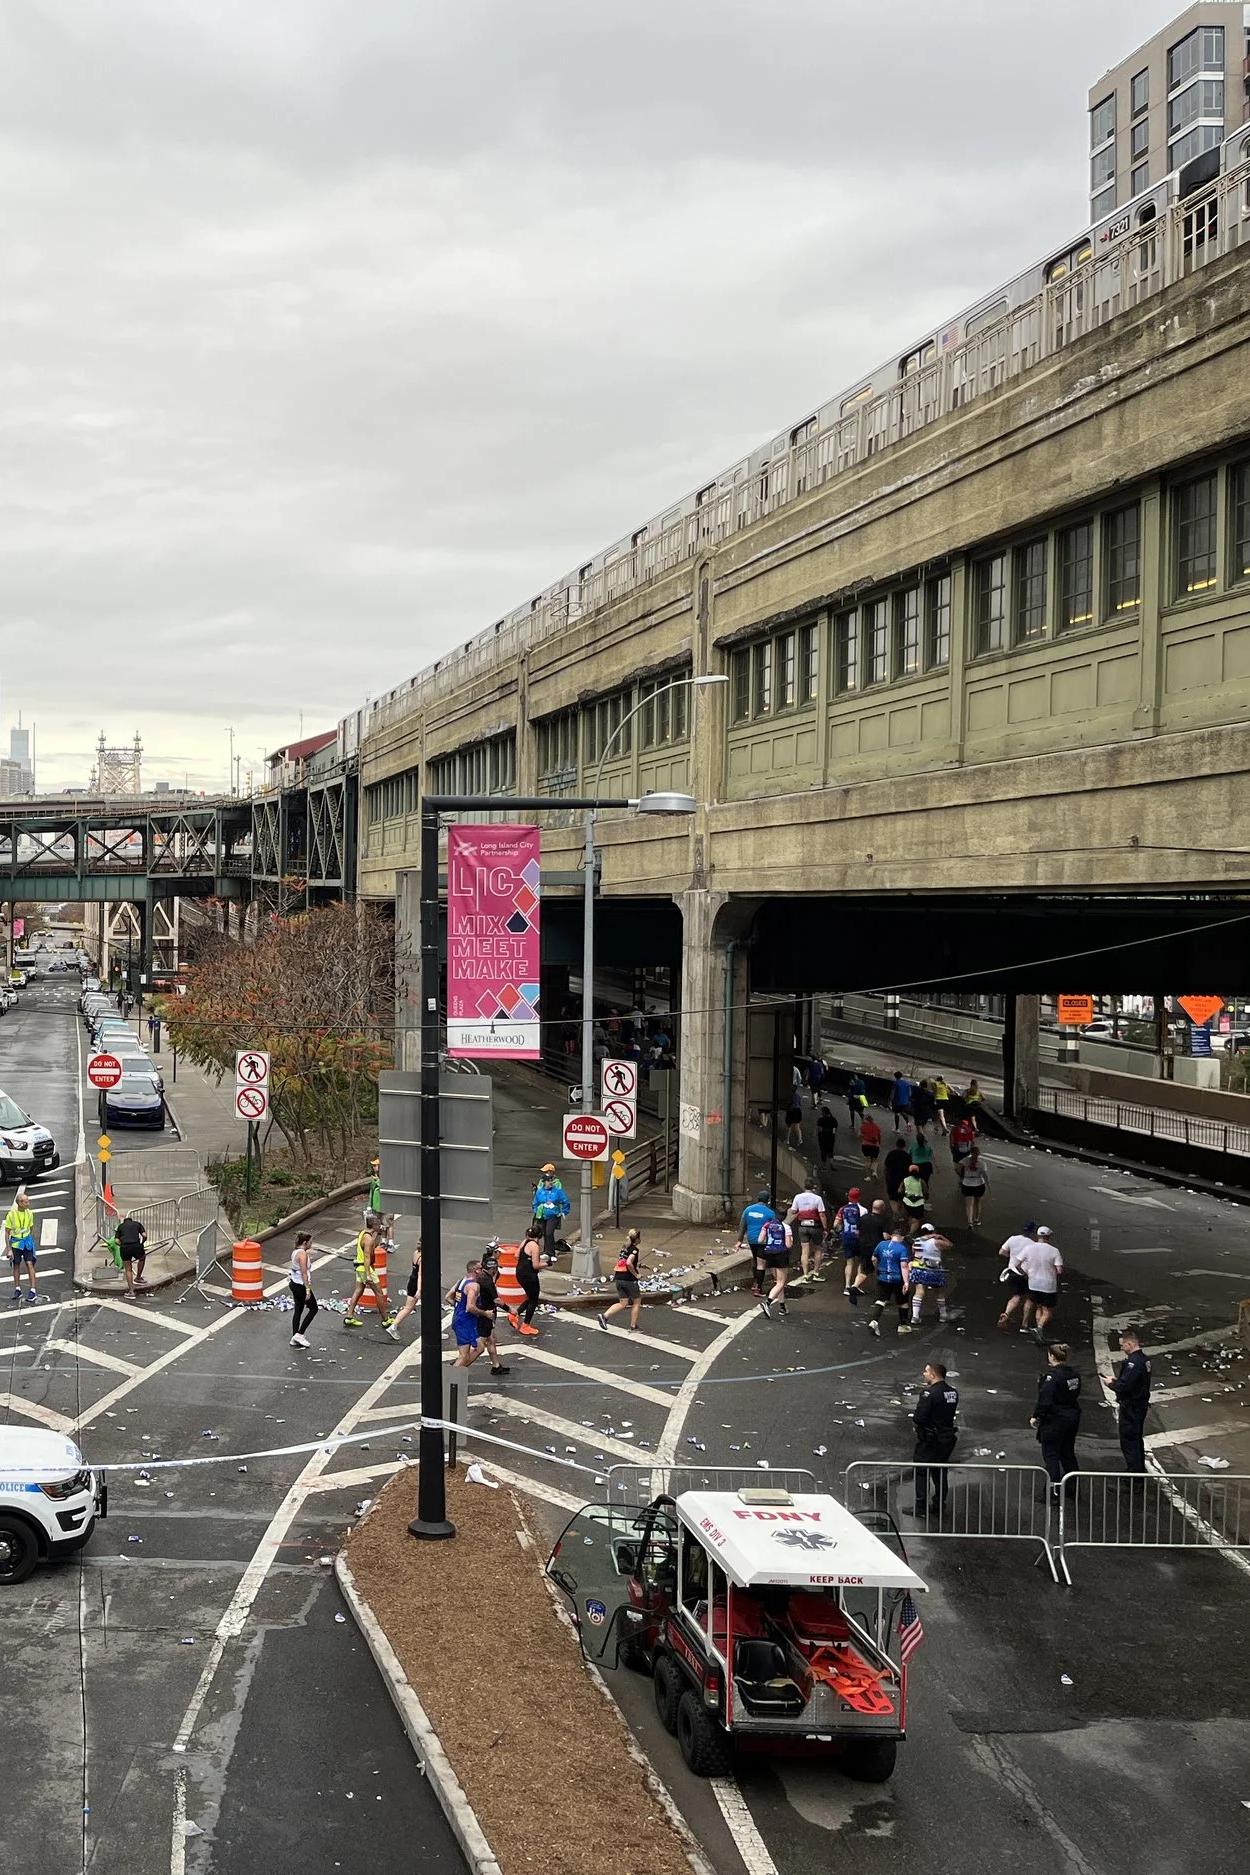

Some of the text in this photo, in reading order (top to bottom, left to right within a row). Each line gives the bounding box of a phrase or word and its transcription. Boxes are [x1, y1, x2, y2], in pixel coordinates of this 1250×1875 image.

[1110, 216, 1129, 239] 7321
[519, 842, 534, 850] City
[452, 860, 514, 912] LIC
[452, 909, 504, 935] MIX
[452, 937, 526, 958] MEET
[452, 960, 528, 980] MAKE
[461, 1033, 525, 1046] HEATHERWOOD
[573, 1143, 598, 1151] ENTER
[732, 1510, 822, 1522] FDNY
[700, 1518, 727, 1547] EMS DIV 3
[810, 1576, 864, 1584] KEEP BACK
